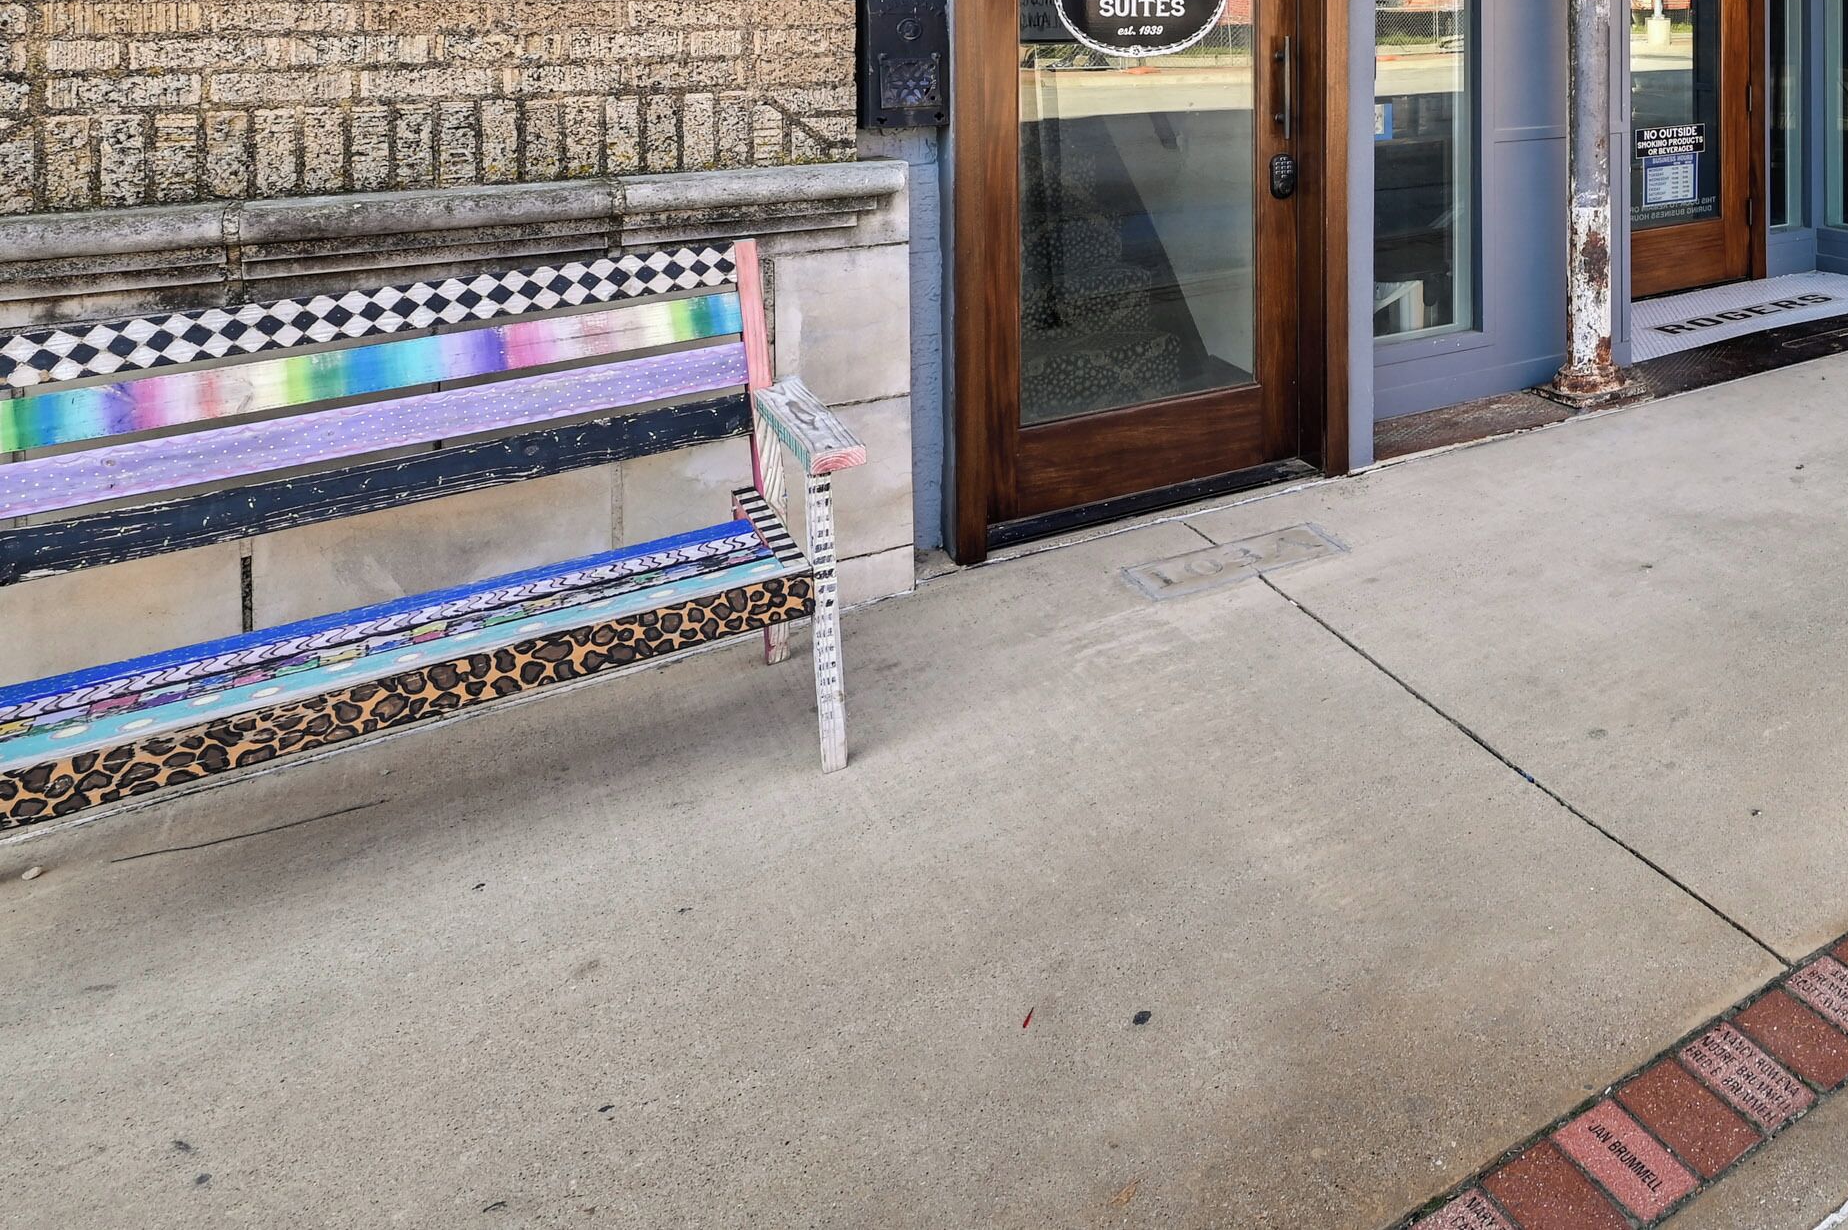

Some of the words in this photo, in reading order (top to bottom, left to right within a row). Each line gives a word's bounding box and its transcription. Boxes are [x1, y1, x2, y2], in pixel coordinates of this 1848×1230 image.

[1117, 25, 1136, 36] est.
[1139, 25, 1164, 36] 1939
[1637, 139, 1667, 149] SMOKING
[1668, 136, 1703, 146] PRODUCTS
[1643, 130, 1658, 140] NO
[1659, 126, 1697, 138] OUTSIDE
[1658, 144, 1694, 155] BEVERAGES
[1654, 294, 1833, 335] ROGERS
[1721, 1031, 1757, 1059] NANCY
[1756, 1058, 1800, 1097] ROWENA
[1685, 1045, 1713, 1069] FRED
[1722, 1076, 1777, 1123] BRUMMELL
[1736, 1066, 1791, 1113] BRUMMELL
[1588, 1124, 1613, 1143] JAN
[1608, 1140, 1663, 1193] BRUMMELL
[1466, 1196, 1497, 1228] MARY
